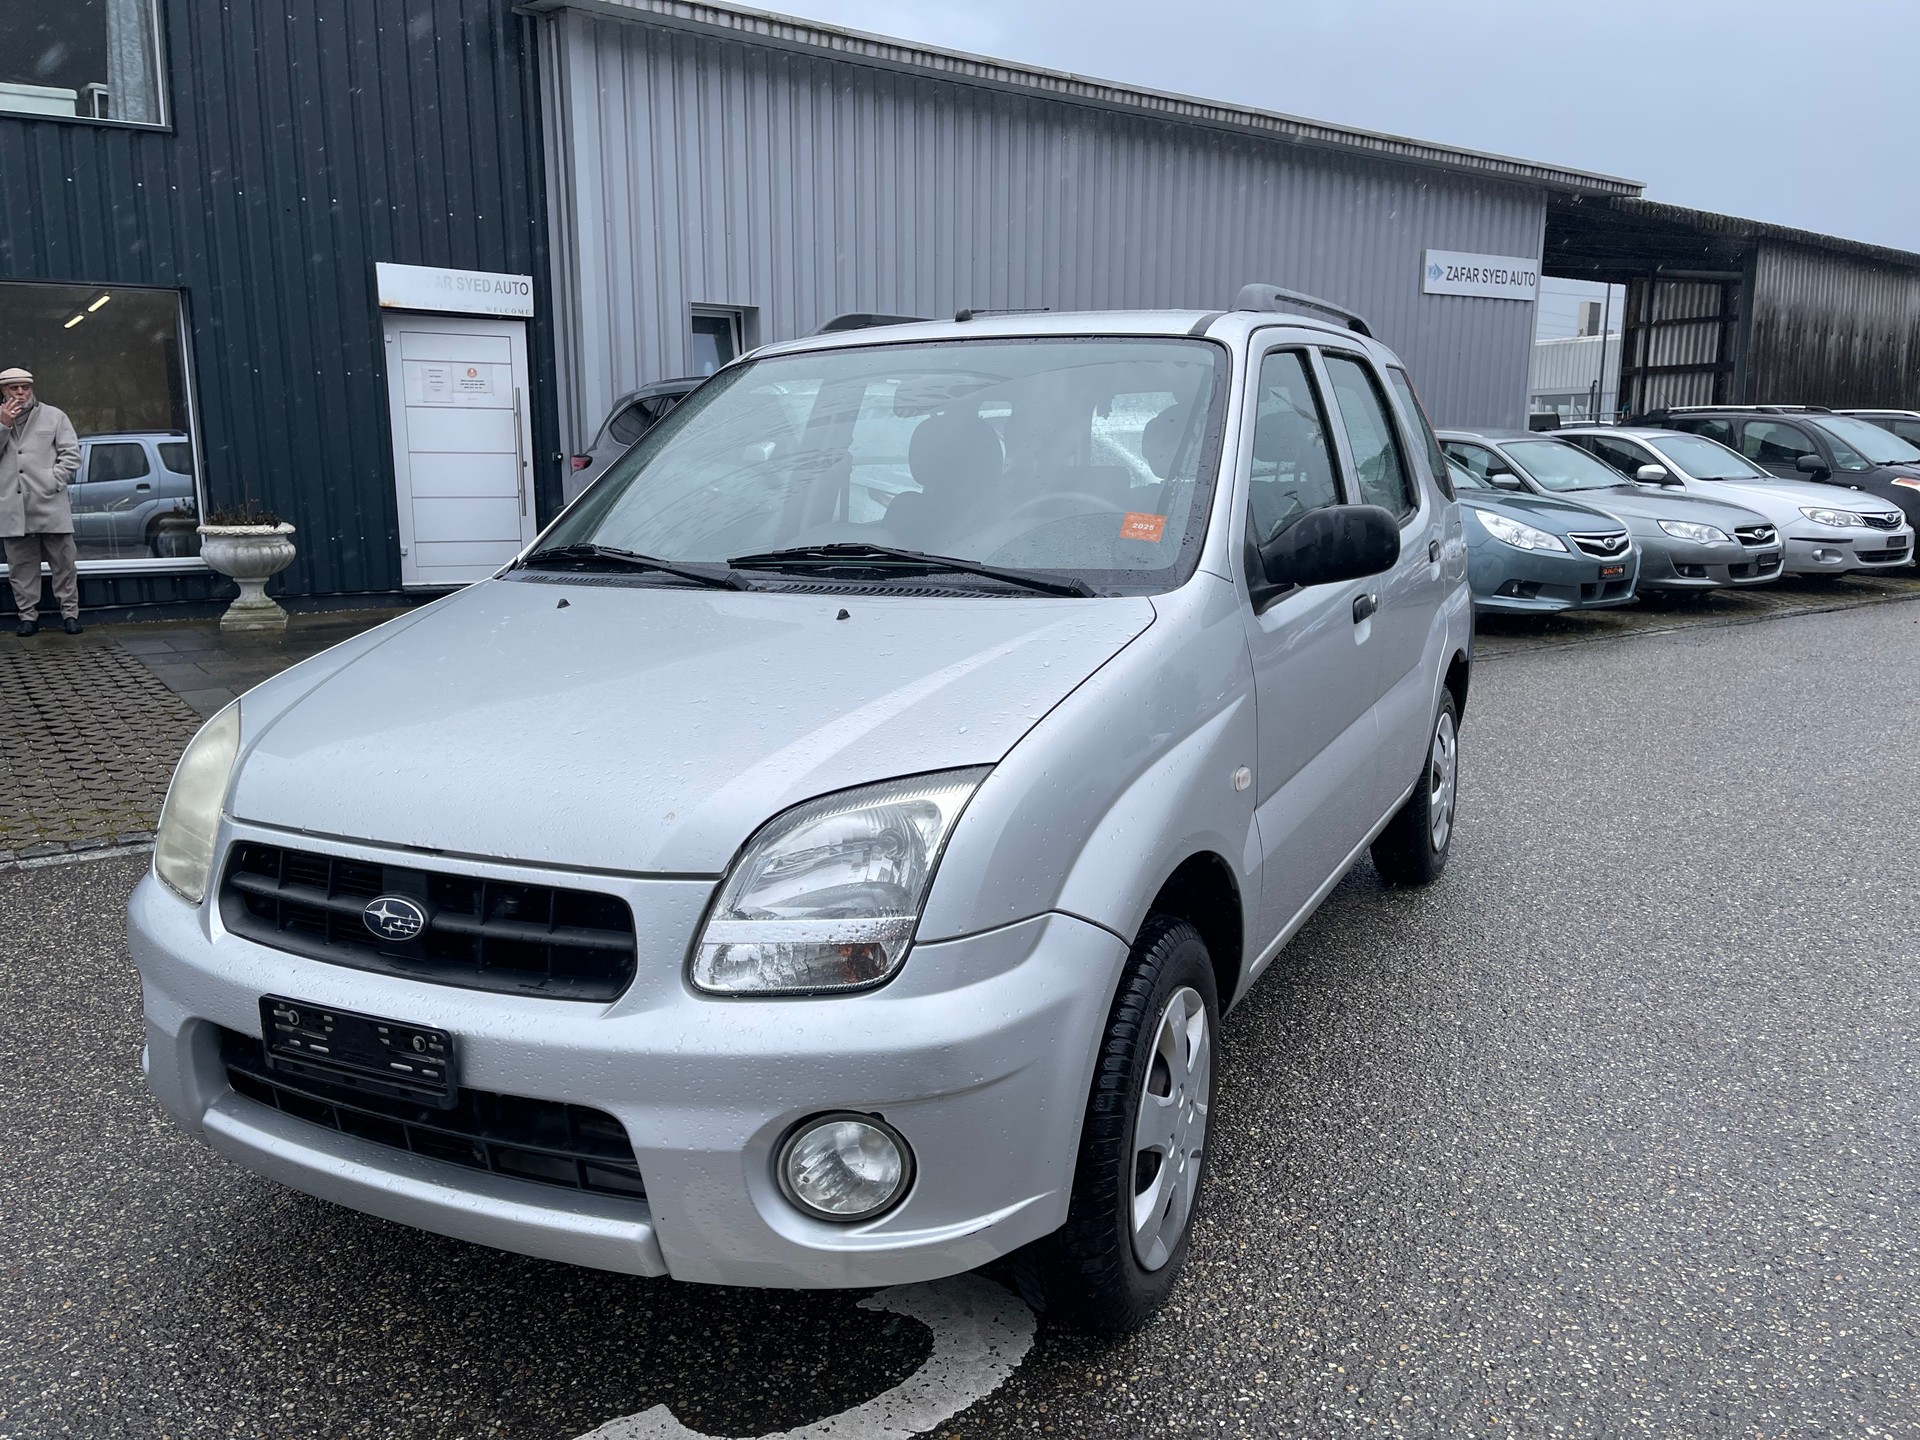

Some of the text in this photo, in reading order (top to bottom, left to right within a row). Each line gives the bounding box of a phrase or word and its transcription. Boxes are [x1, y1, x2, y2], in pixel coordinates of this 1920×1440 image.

[1446, 266, 1536, 287] ZAFAR SYED AUTO
[456, 276, 491, 293] SYED
[494, 280, 529, 296] AUTO
[485, 306, 531, 316] WELCOME
[1132, 522, 1155, 531] 2025
